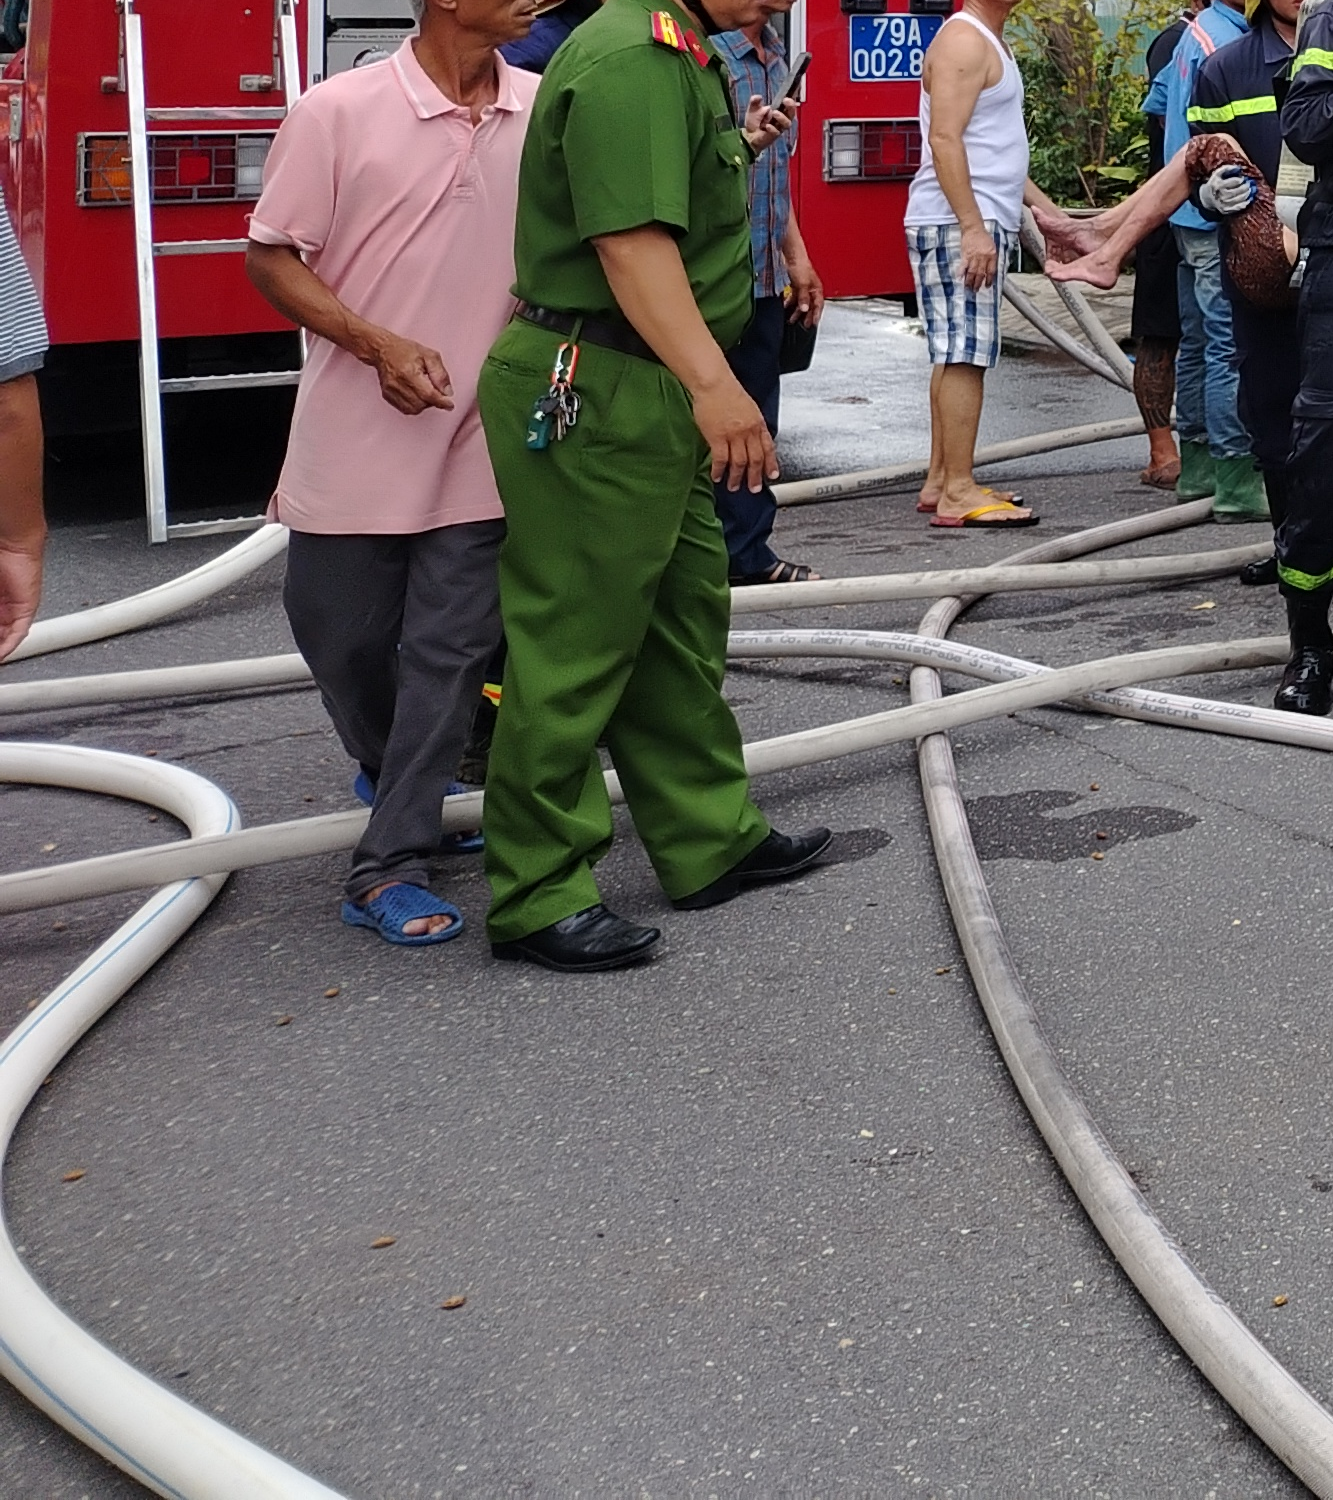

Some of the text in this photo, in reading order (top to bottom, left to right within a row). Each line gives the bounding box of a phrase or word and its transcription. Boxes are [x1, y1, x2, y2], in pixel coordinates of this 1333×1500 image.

[873, 18, 922, 46] 79A
[853, 48, 925, 77] 002.8
[1140, 703, 1200, 721] Austria
